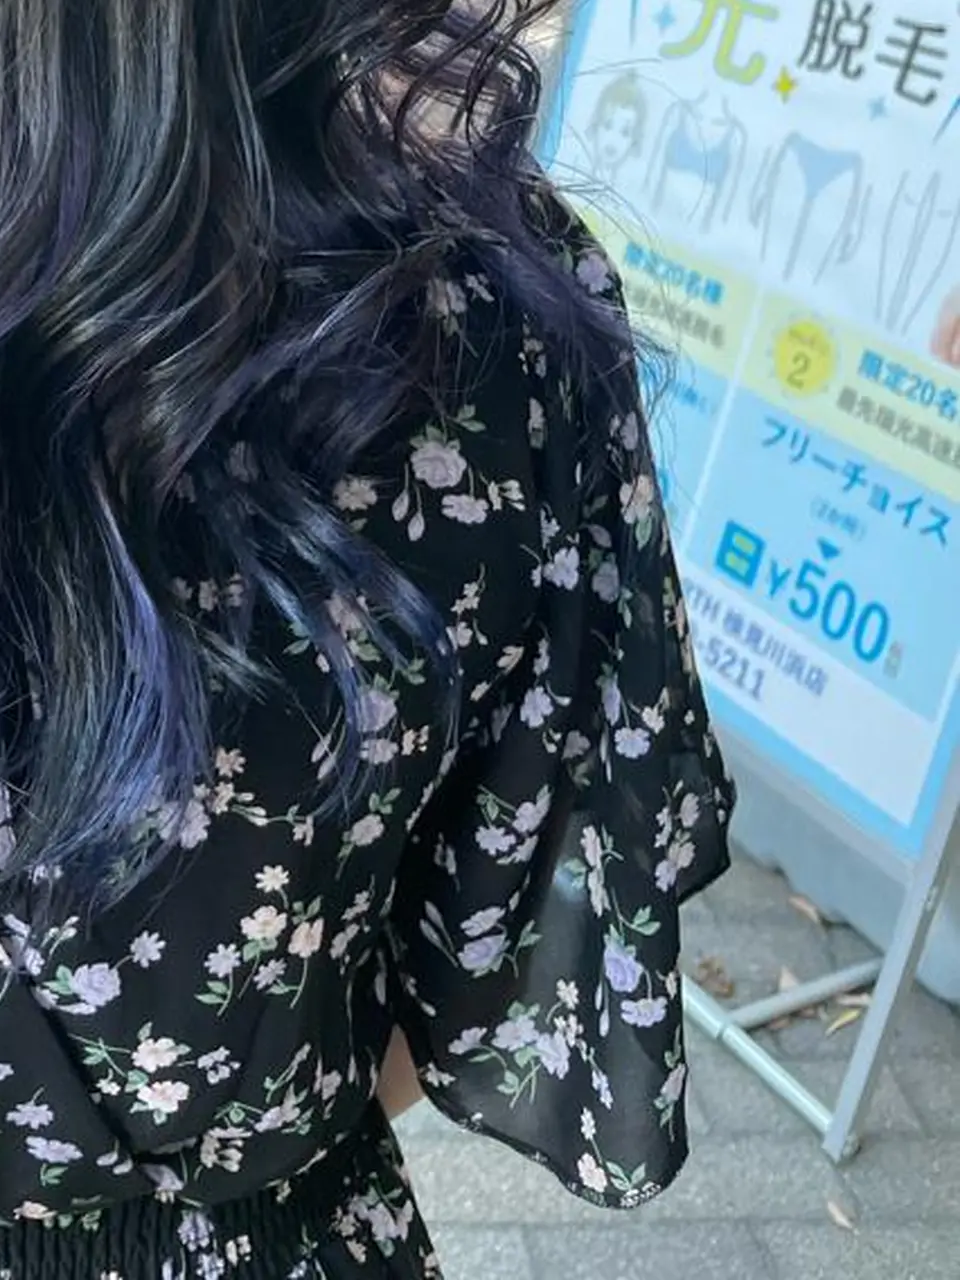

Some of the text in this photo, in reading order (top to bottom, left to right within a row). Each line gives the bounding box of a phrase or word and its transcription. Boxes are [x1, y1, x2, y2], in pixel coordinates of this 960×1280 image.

[762, 417, 953, 545] フリーチョイス
